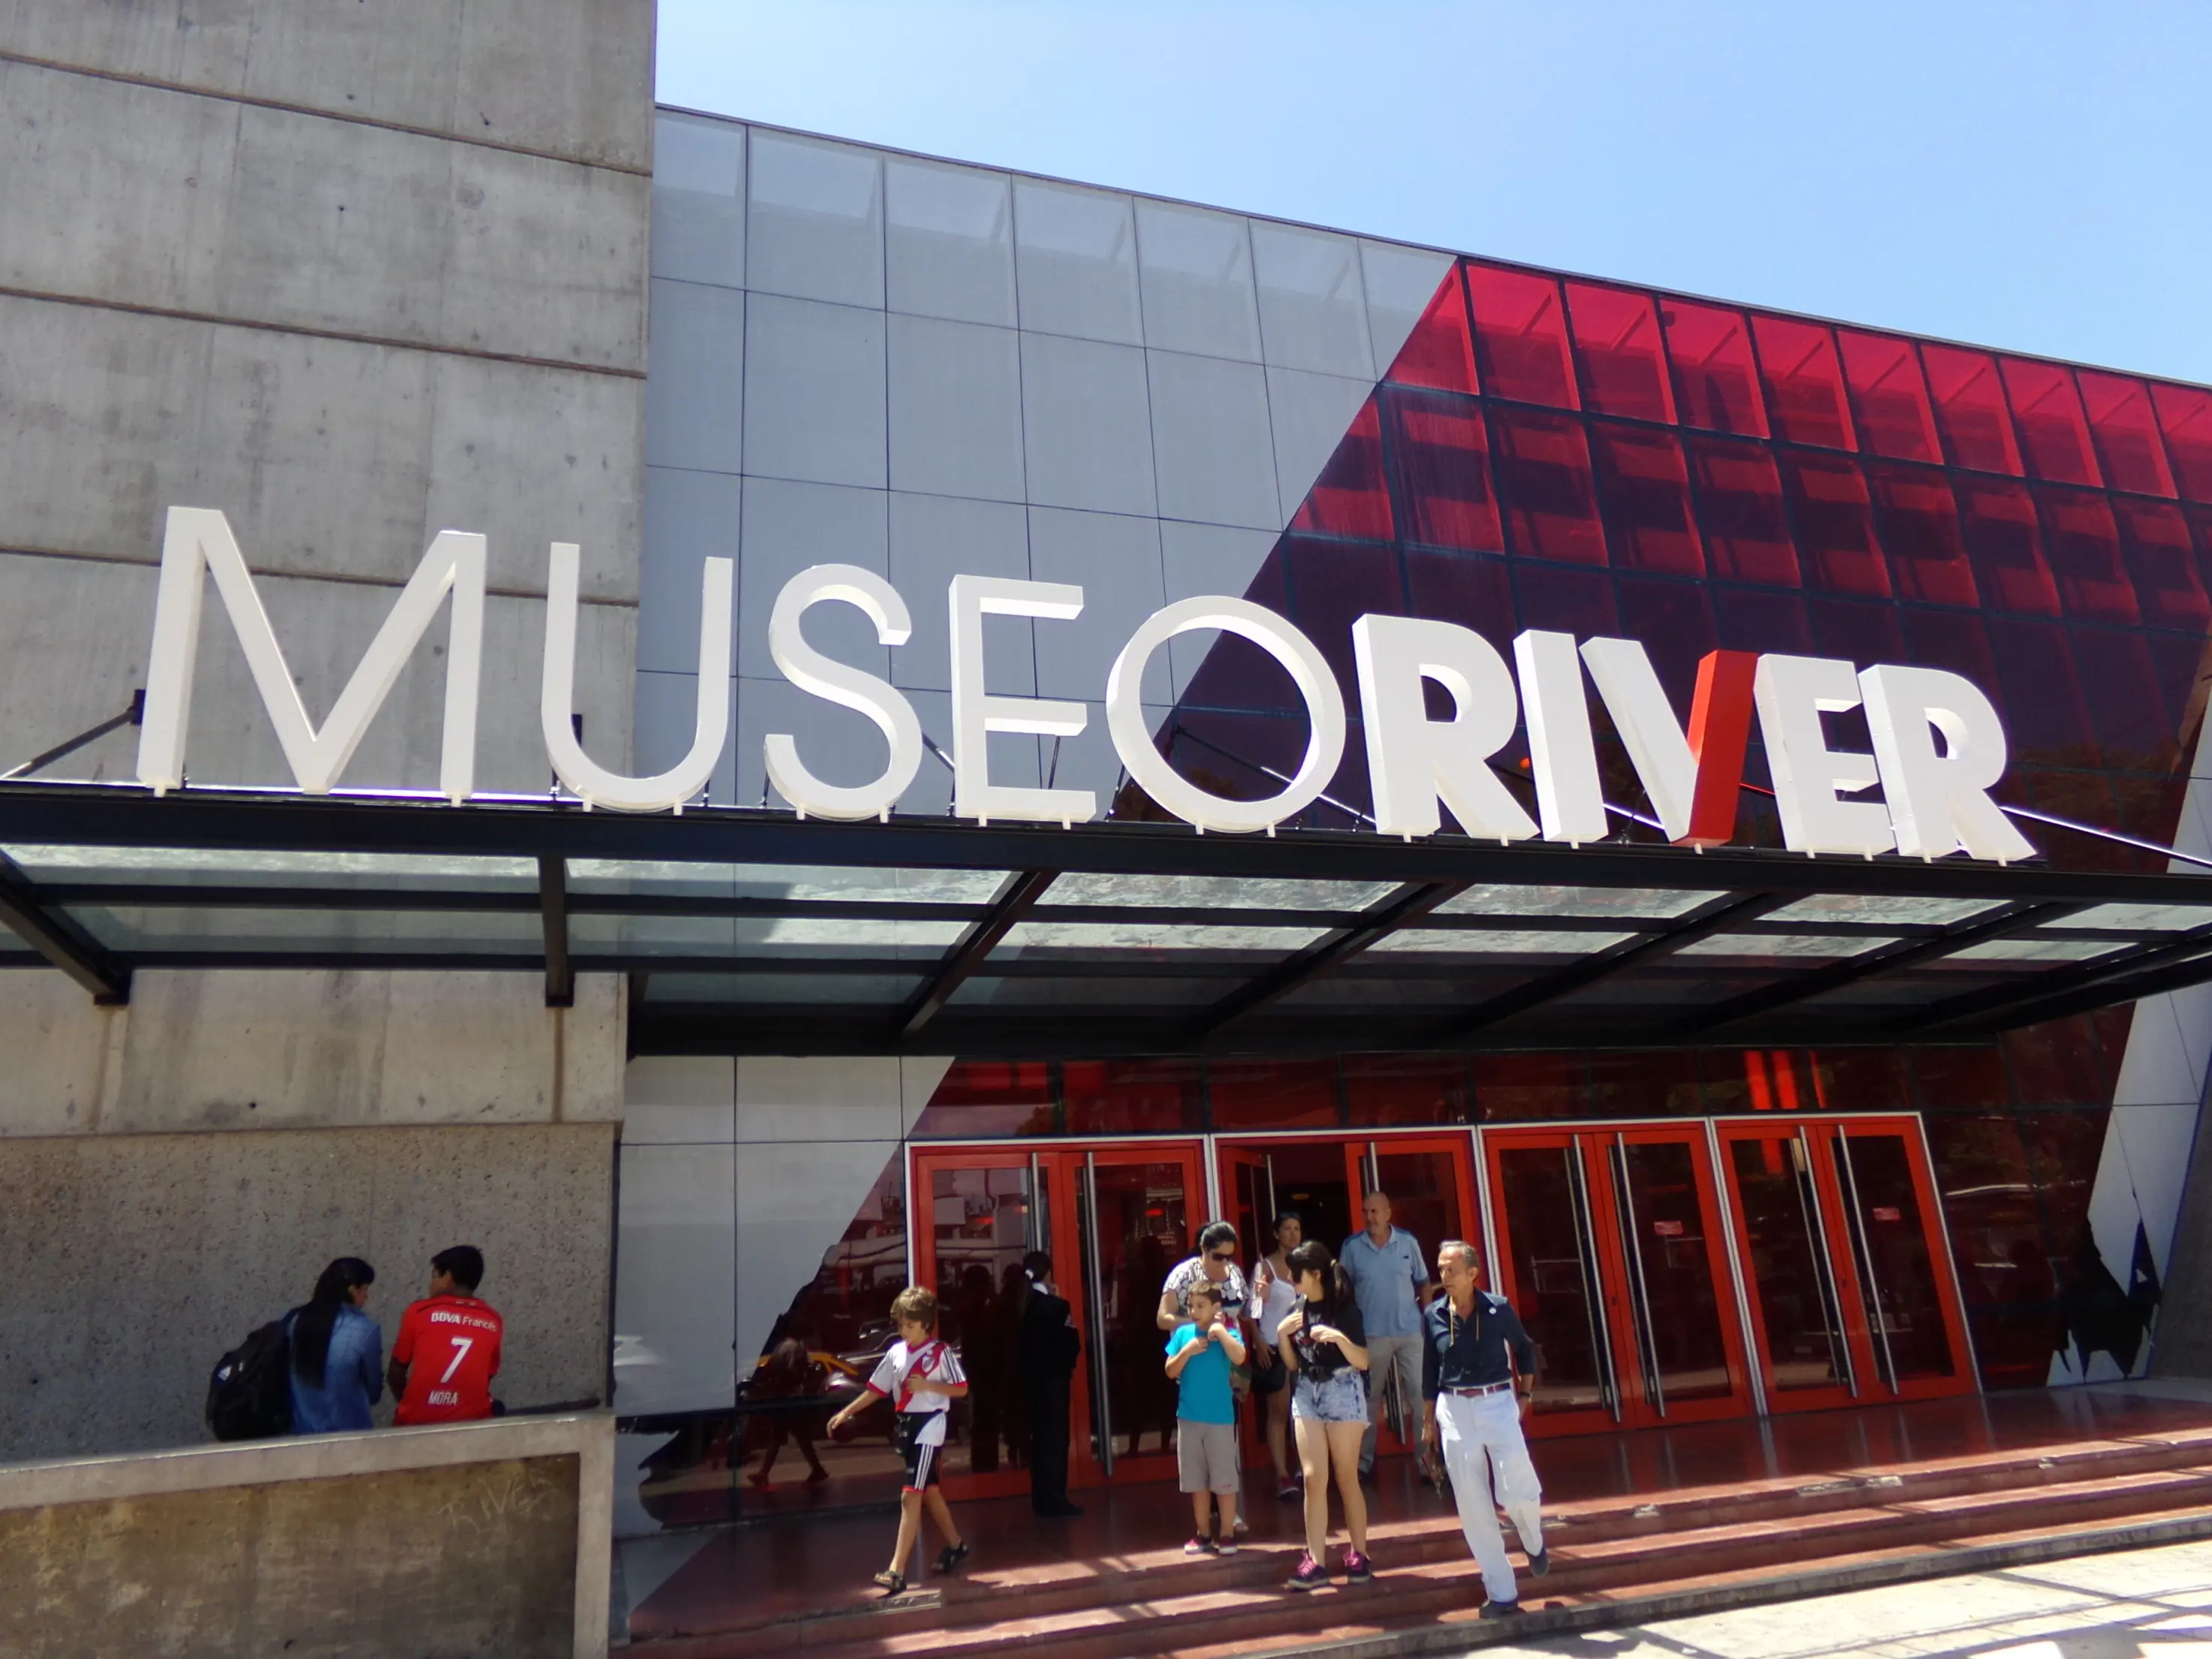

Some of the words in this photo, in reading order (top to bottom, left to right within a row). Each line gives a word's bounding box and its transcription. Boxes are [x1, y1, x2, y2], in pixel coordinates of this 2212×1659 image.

[431, 1312, 460, 1325] BBVA
[440, 1337, 473, 1383] 7
[428, 1391, 458, 1406] MORA
